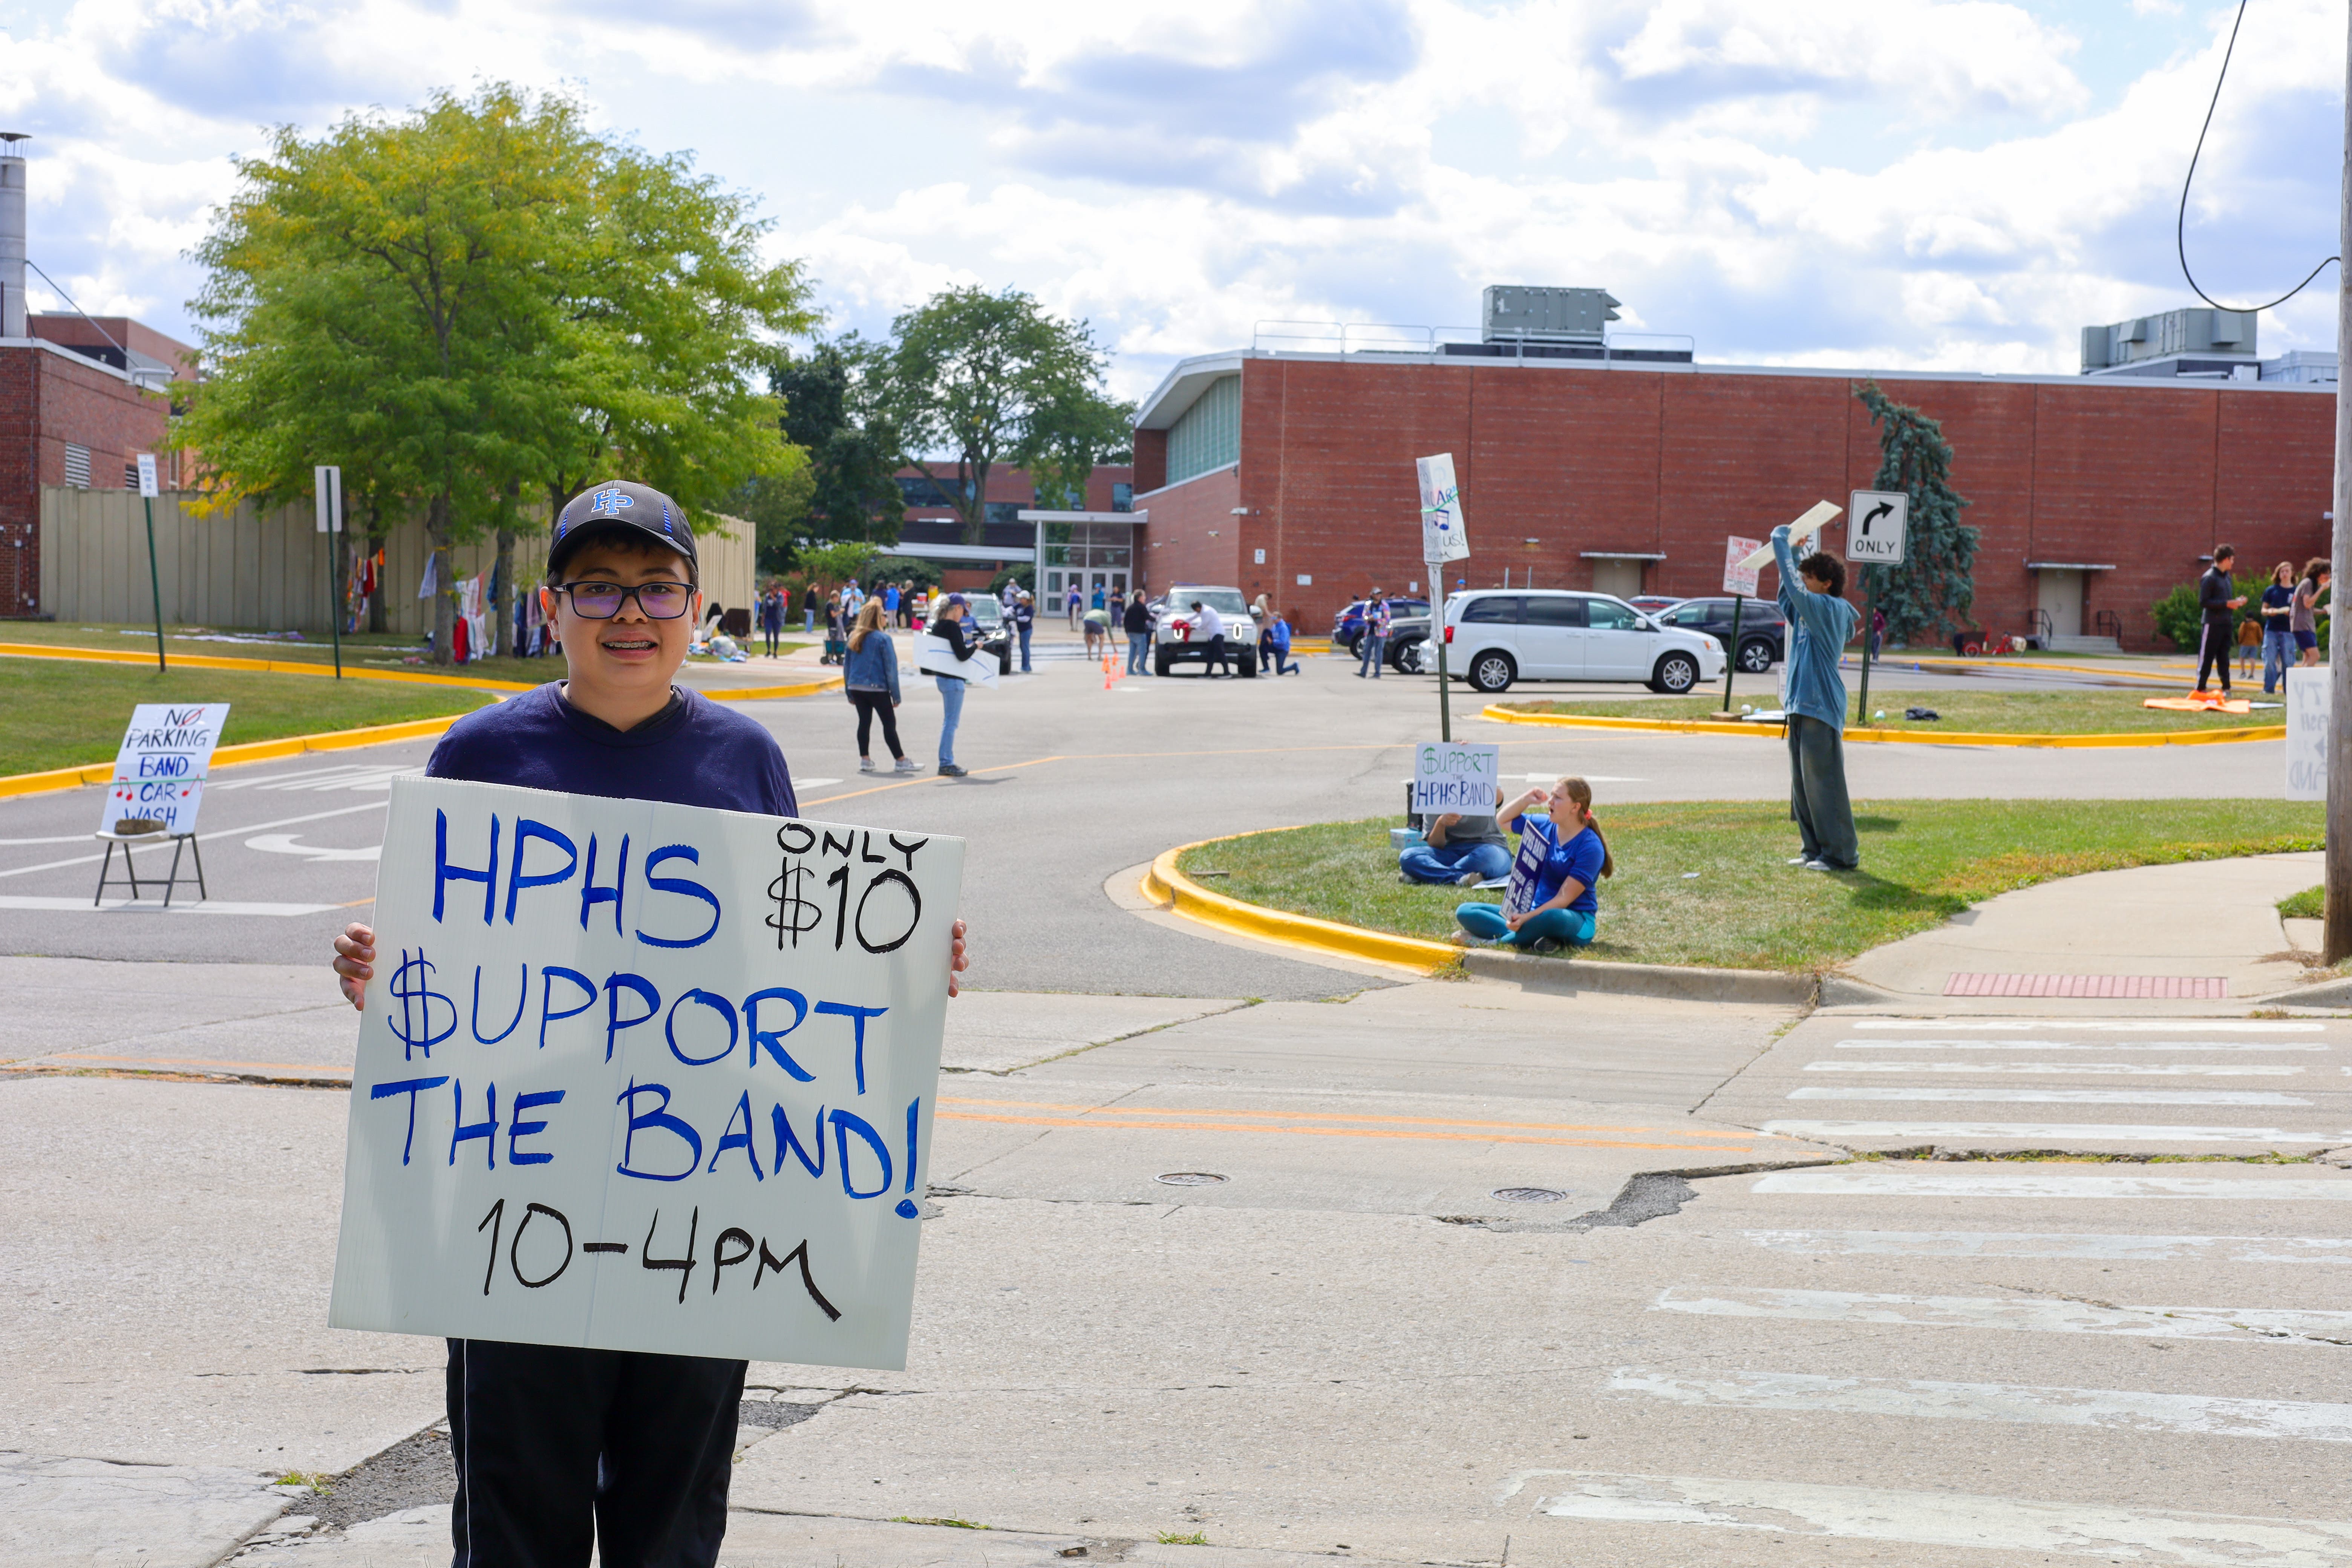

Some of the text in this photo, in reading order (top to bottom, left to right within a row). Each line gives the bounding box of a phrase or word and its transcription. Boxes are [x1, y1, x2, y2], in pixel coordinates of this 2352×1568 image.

[591, 488, 634, 516] HP
[1856, 540, 1895, 554] ONLY
[164, 709, 202, 727] NO
[126, 728, 210, 748] PARKING
[139, 756, 188, 777] BAND
[1422, 746, 1493, 775] $UPPORT
[140, 782, 176, 802] CAR
[1416, 780, 1494, 807] HPHS BAND
[777, 822, 929, 872] ONLY
[432, 808, 721, 949] HPHS
[765, 857, 921, 954] $10
[387, 946, 889, 1096] $UPPORT
[370, 1075, 920, 1219] THE BAND!
